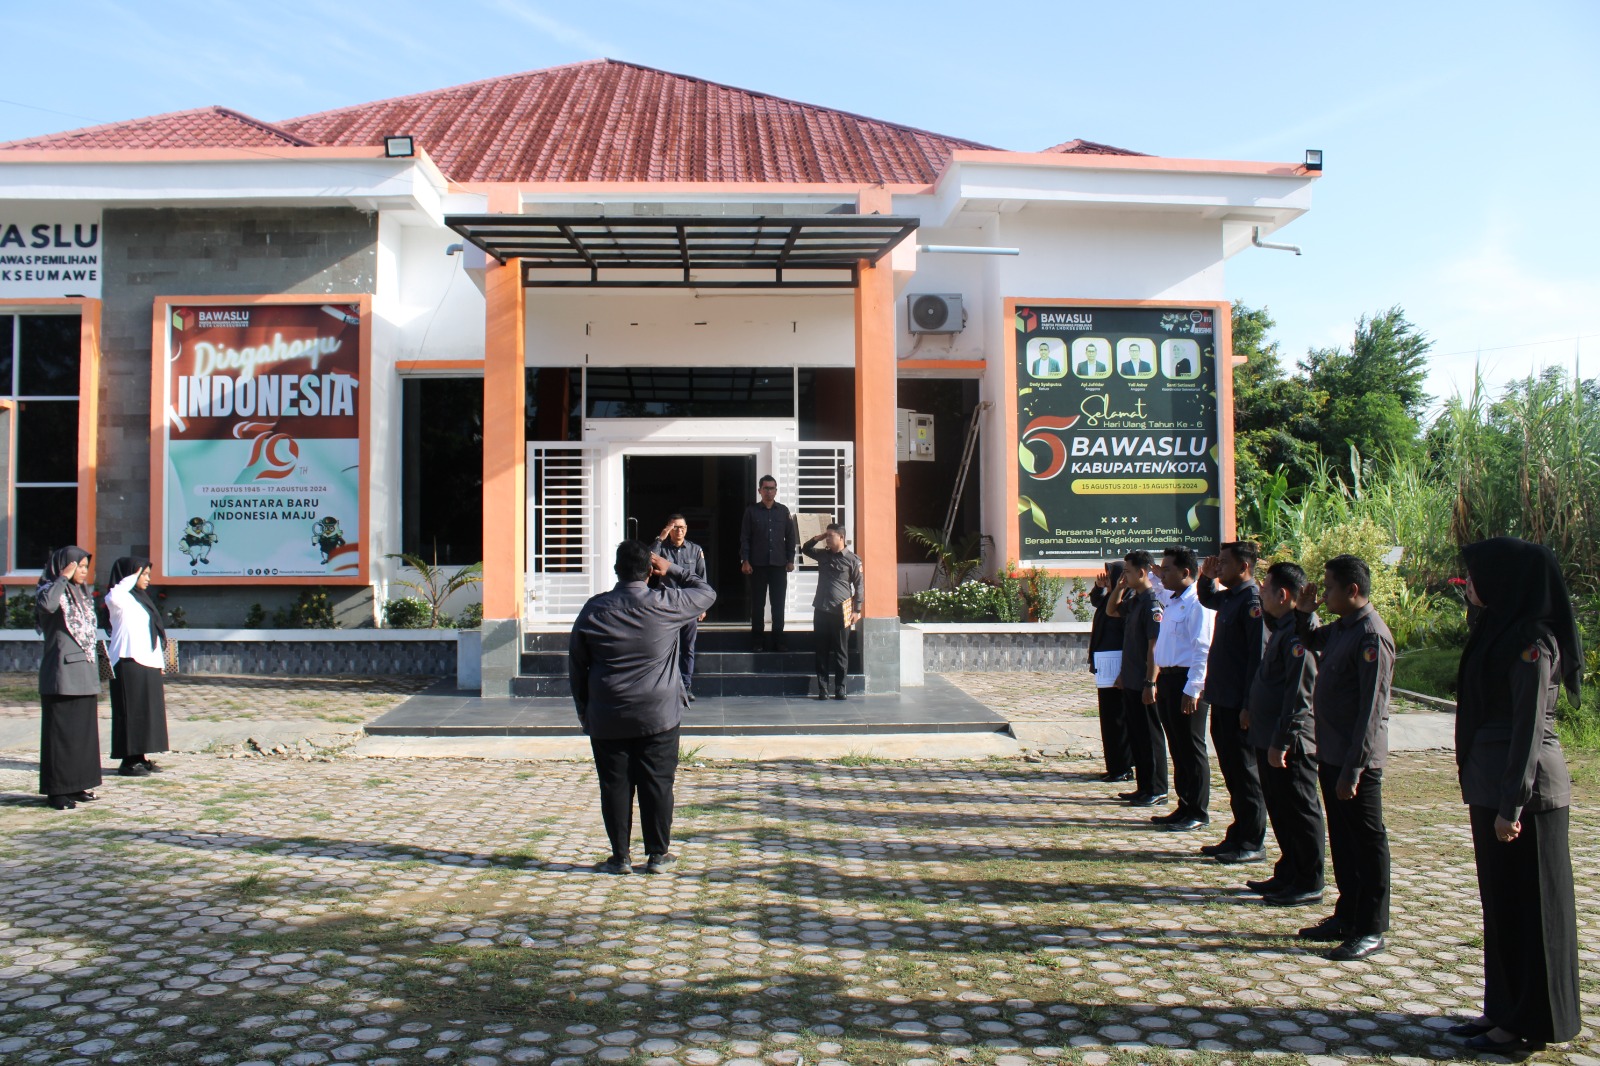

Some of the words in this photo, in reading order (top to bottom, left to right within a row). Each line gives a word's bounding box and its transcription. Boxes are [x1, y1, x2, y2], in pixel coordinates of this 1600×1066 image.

[0, 224, 98, 249] ASLU
[34, 255, 97, 265] PEMILIHAN
[2, 270, 97, 281] KSEUMAWE
[199, 311, 249, 321] BAWASLU
[1041, 313, 1092, 323] BAWASLU
[194, 332, 342, 379] Dirgahayu
[178, 374, 354, 417] INDONESIA
[1080, 394, 1148, 426] Selamat
[1122, 421, 1147, 430] Ulang
[1071, 436, 1208, 457] BAWASLU
[300, 466, 308, 474] TH
[1071, 460, 1208, 474] KABUPATEN/KOTA
[210, 499, 284, 508] NUSANTARA
[287, 499, 320, 508] BARU
[213, 511, 278, 520] INDONESIA
[282, 511, 316, 520] MAJU
[1095, 528, 1126, 536] Rakyat
[1104, 536, 1145, 544] Tegakkan
